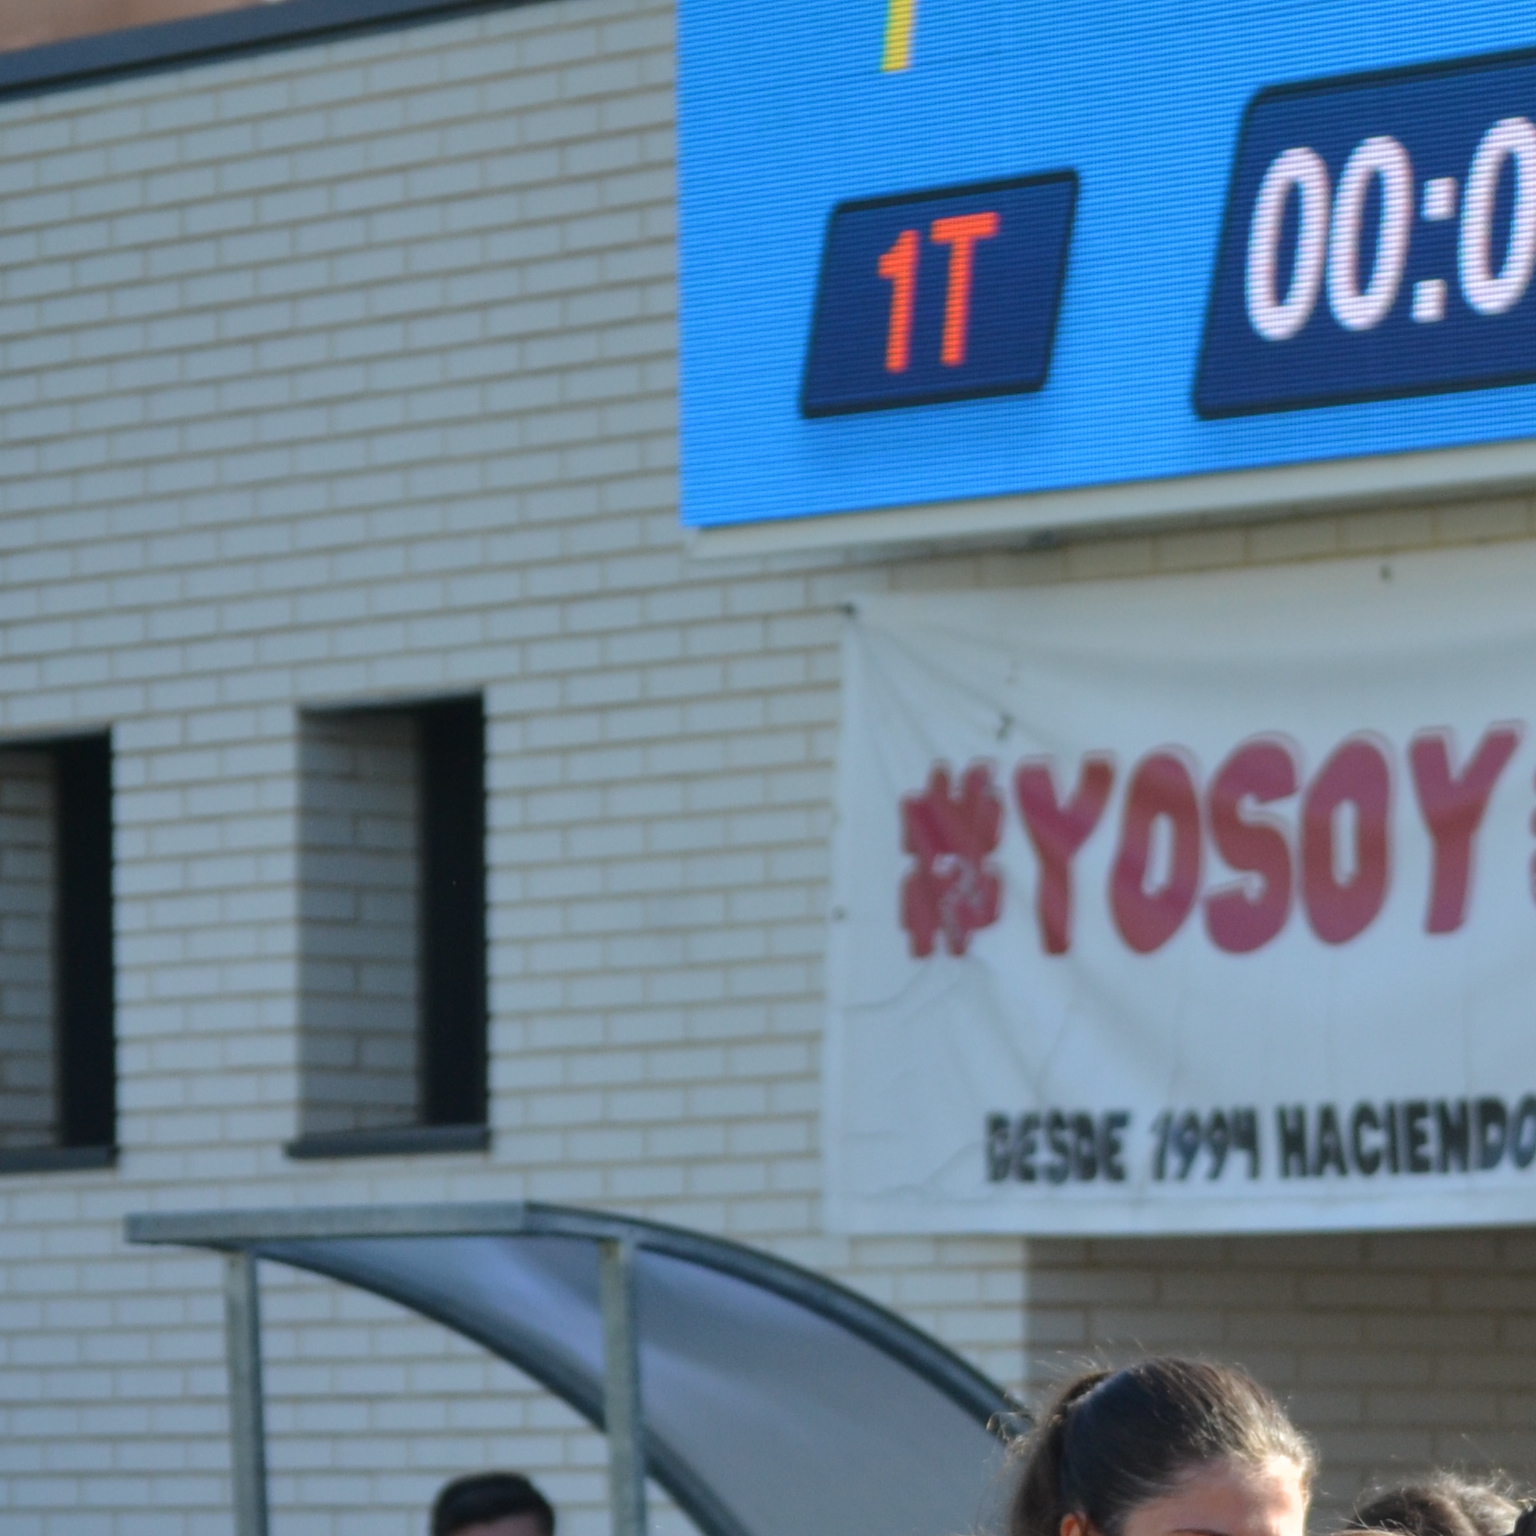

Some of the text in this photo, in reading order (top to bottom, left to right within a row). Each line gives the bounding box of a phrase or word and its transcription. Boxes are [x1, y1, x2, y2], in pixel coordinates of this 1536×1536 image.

[876, 210, 1000, 374] 1T
[986, 1108, 1129, 1185] DESDE
[1150, 1106, 1260, 1181] 1994
